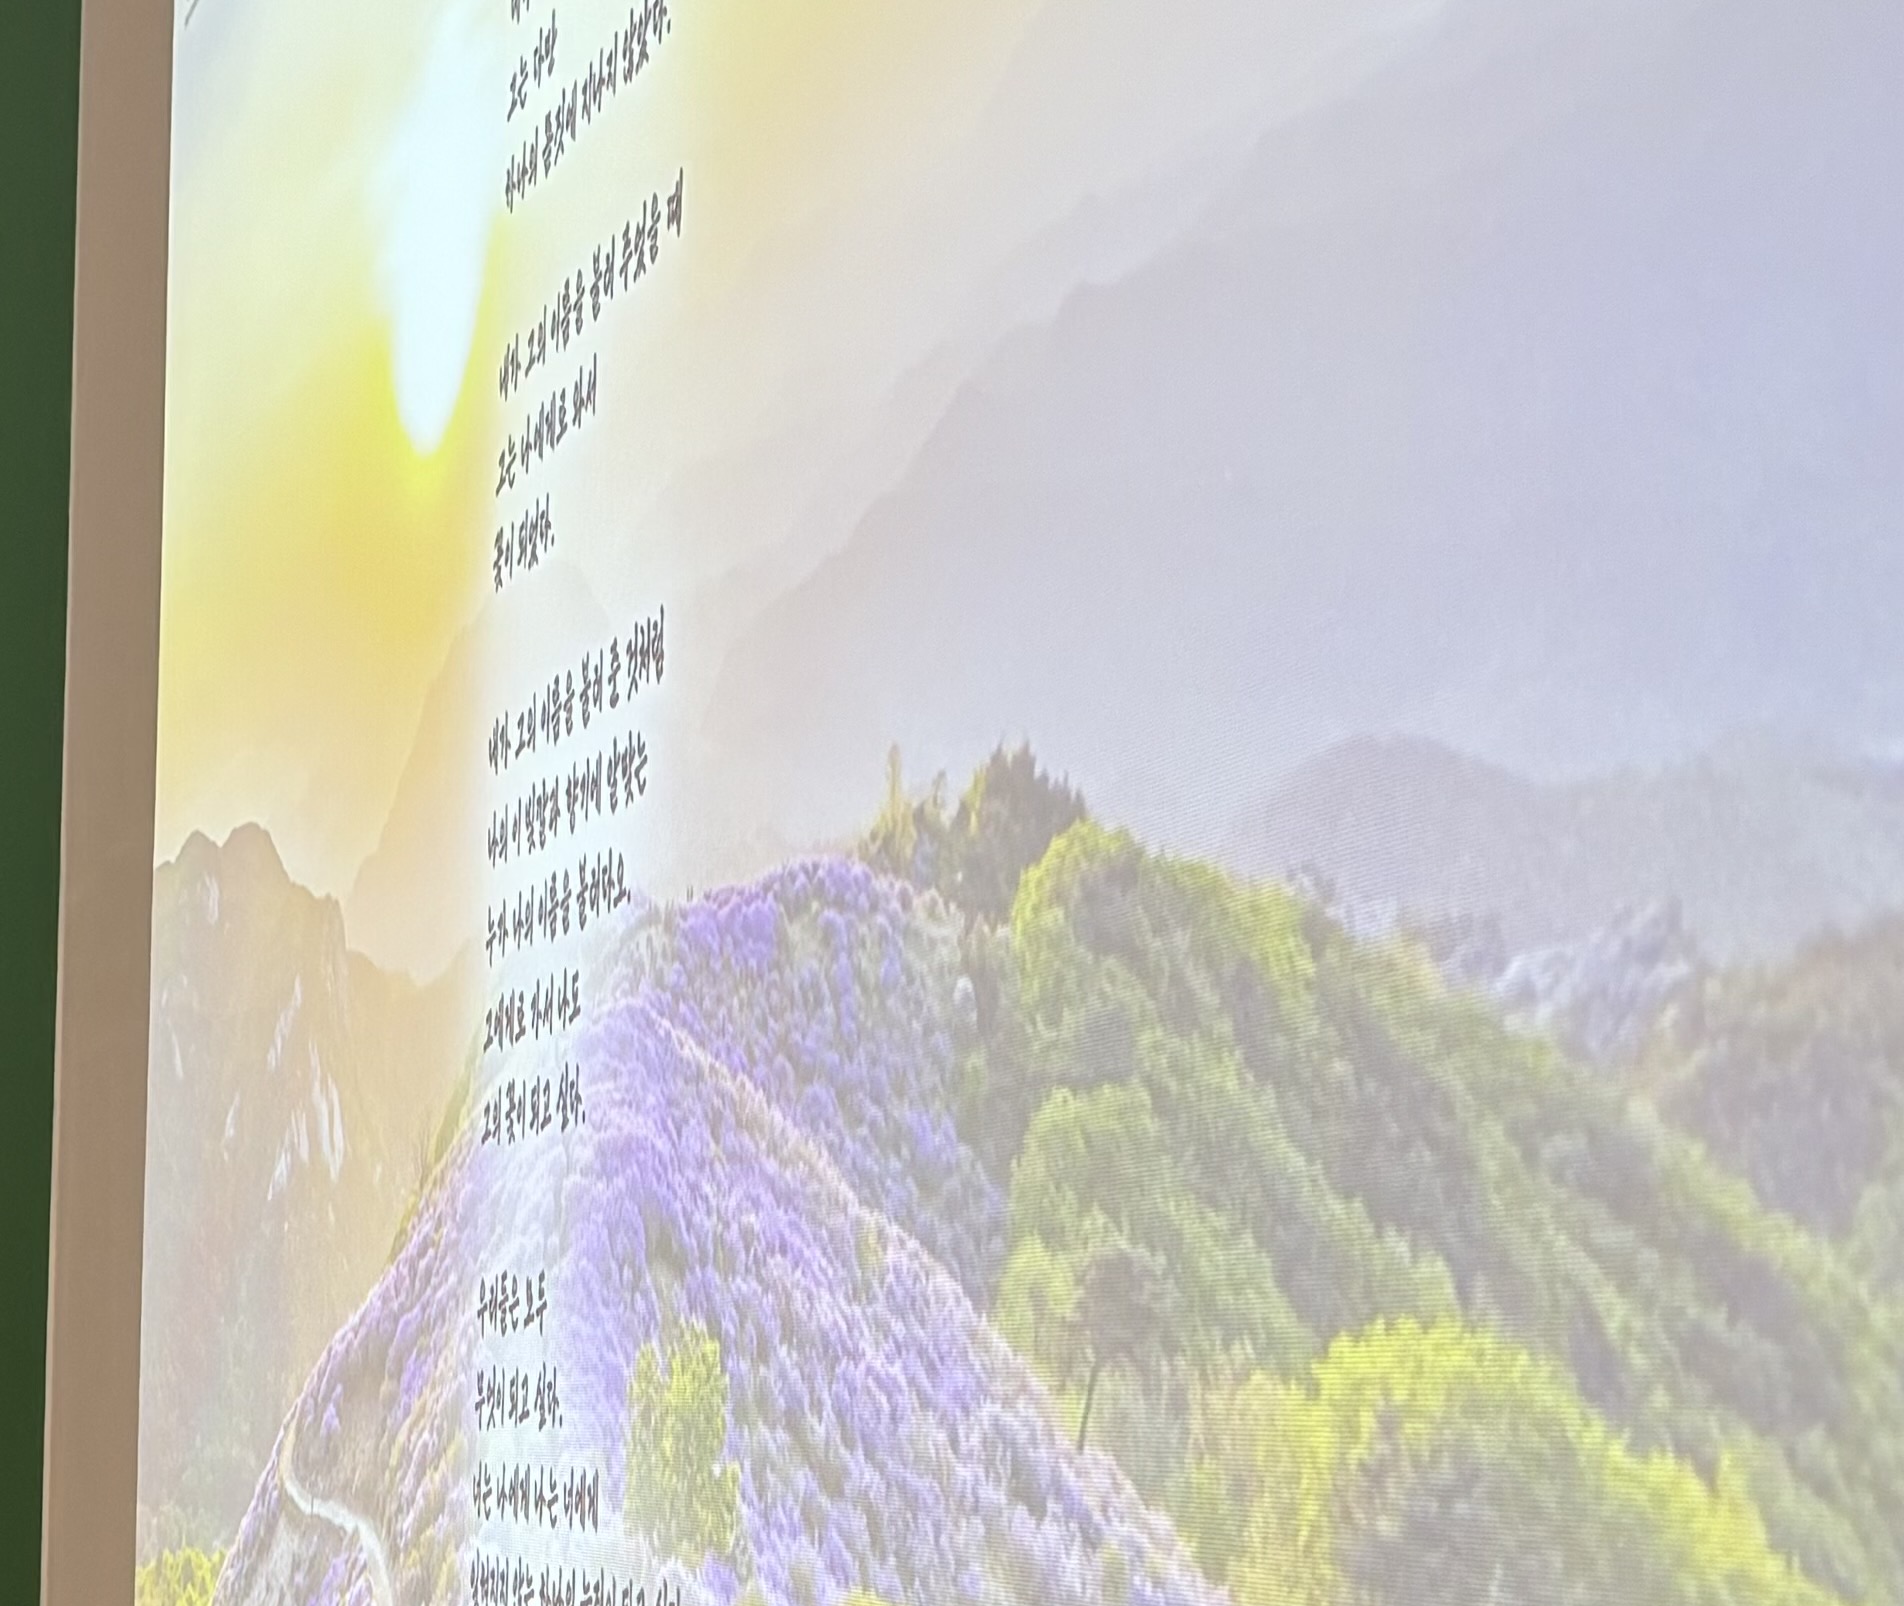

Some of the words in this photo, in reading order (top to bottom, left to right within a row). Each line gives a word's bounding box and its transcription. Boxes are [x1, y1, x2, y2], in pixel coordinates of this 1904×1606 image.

[507, 54, 529, 122] 그는
[534, 8, 557, 88] 다만
[505, 125, 539, 214] 하나의
[542, 79, 577, 180] 몸짓에
[582, 30, 618, 125] 지나지
[499, 332, 521, 402] 내가
[525, 304, 547, 379] 그의
[551, 268, 585, 352] 이름을
[590, 234, 616, 322] 불러
[620, 192, 661, 292] 주었을
[667, 166, 684, 238] 때
[496, 434, 517, 497] 그는
[521, 388, 567, 475] 나에게로
[572, 352, 597, 429] 와서
[493, 521, 514, 593] 꽃이
[518, 492, 554, 571] 되었다.
[488, 710, 511, 776] 내가
[515, 691, 537, 760] 그의
[541, 669, 575, 746] 이름을
[579, 648, 603, 729] 불러
[607, 636, 621, 709] 준
[626, 602, 665, 703] 것처럼
[488, 802, 508, 868] 나의
[512, 797, 521, 856] 이
[525, 774, 561, 855] 빛깔과
[566, 750, 602, 835] 향기에
[607, 730, 648, 815] 알맞는
[486, 897, 508, 968] 누가
[513, 884, 534, 951] 나의
[538, 868, 572, 943] 이름을
[483, 988, 526, 1054] 그에게로
[531, 972, 554, 1041] 가서
[557, 966, 582, 1031] 나도
[481, 1086, 501, 1146] 그의
[505, 1078, 526, 1146] 꽃이
[529, 1074, 552, 1136] 되고
[556, 1061, 586, 1133] 싶다.
[477, 1269, 520, 1339] 우리들은
[523, 1268, 548, 1336] 모두
[474, 1363, 505, 1431] 무엇이
[509, 1365, 531, 1429] 되고
[534, 1361, 563, 1432] 싶다.
[472, 1460, 493, 1521] 너는
[497, 1462, 531, 1525] 나에게
[534, 1465, 559, 1529] 나는
[563, 1466, 599, 1534] 너에게
